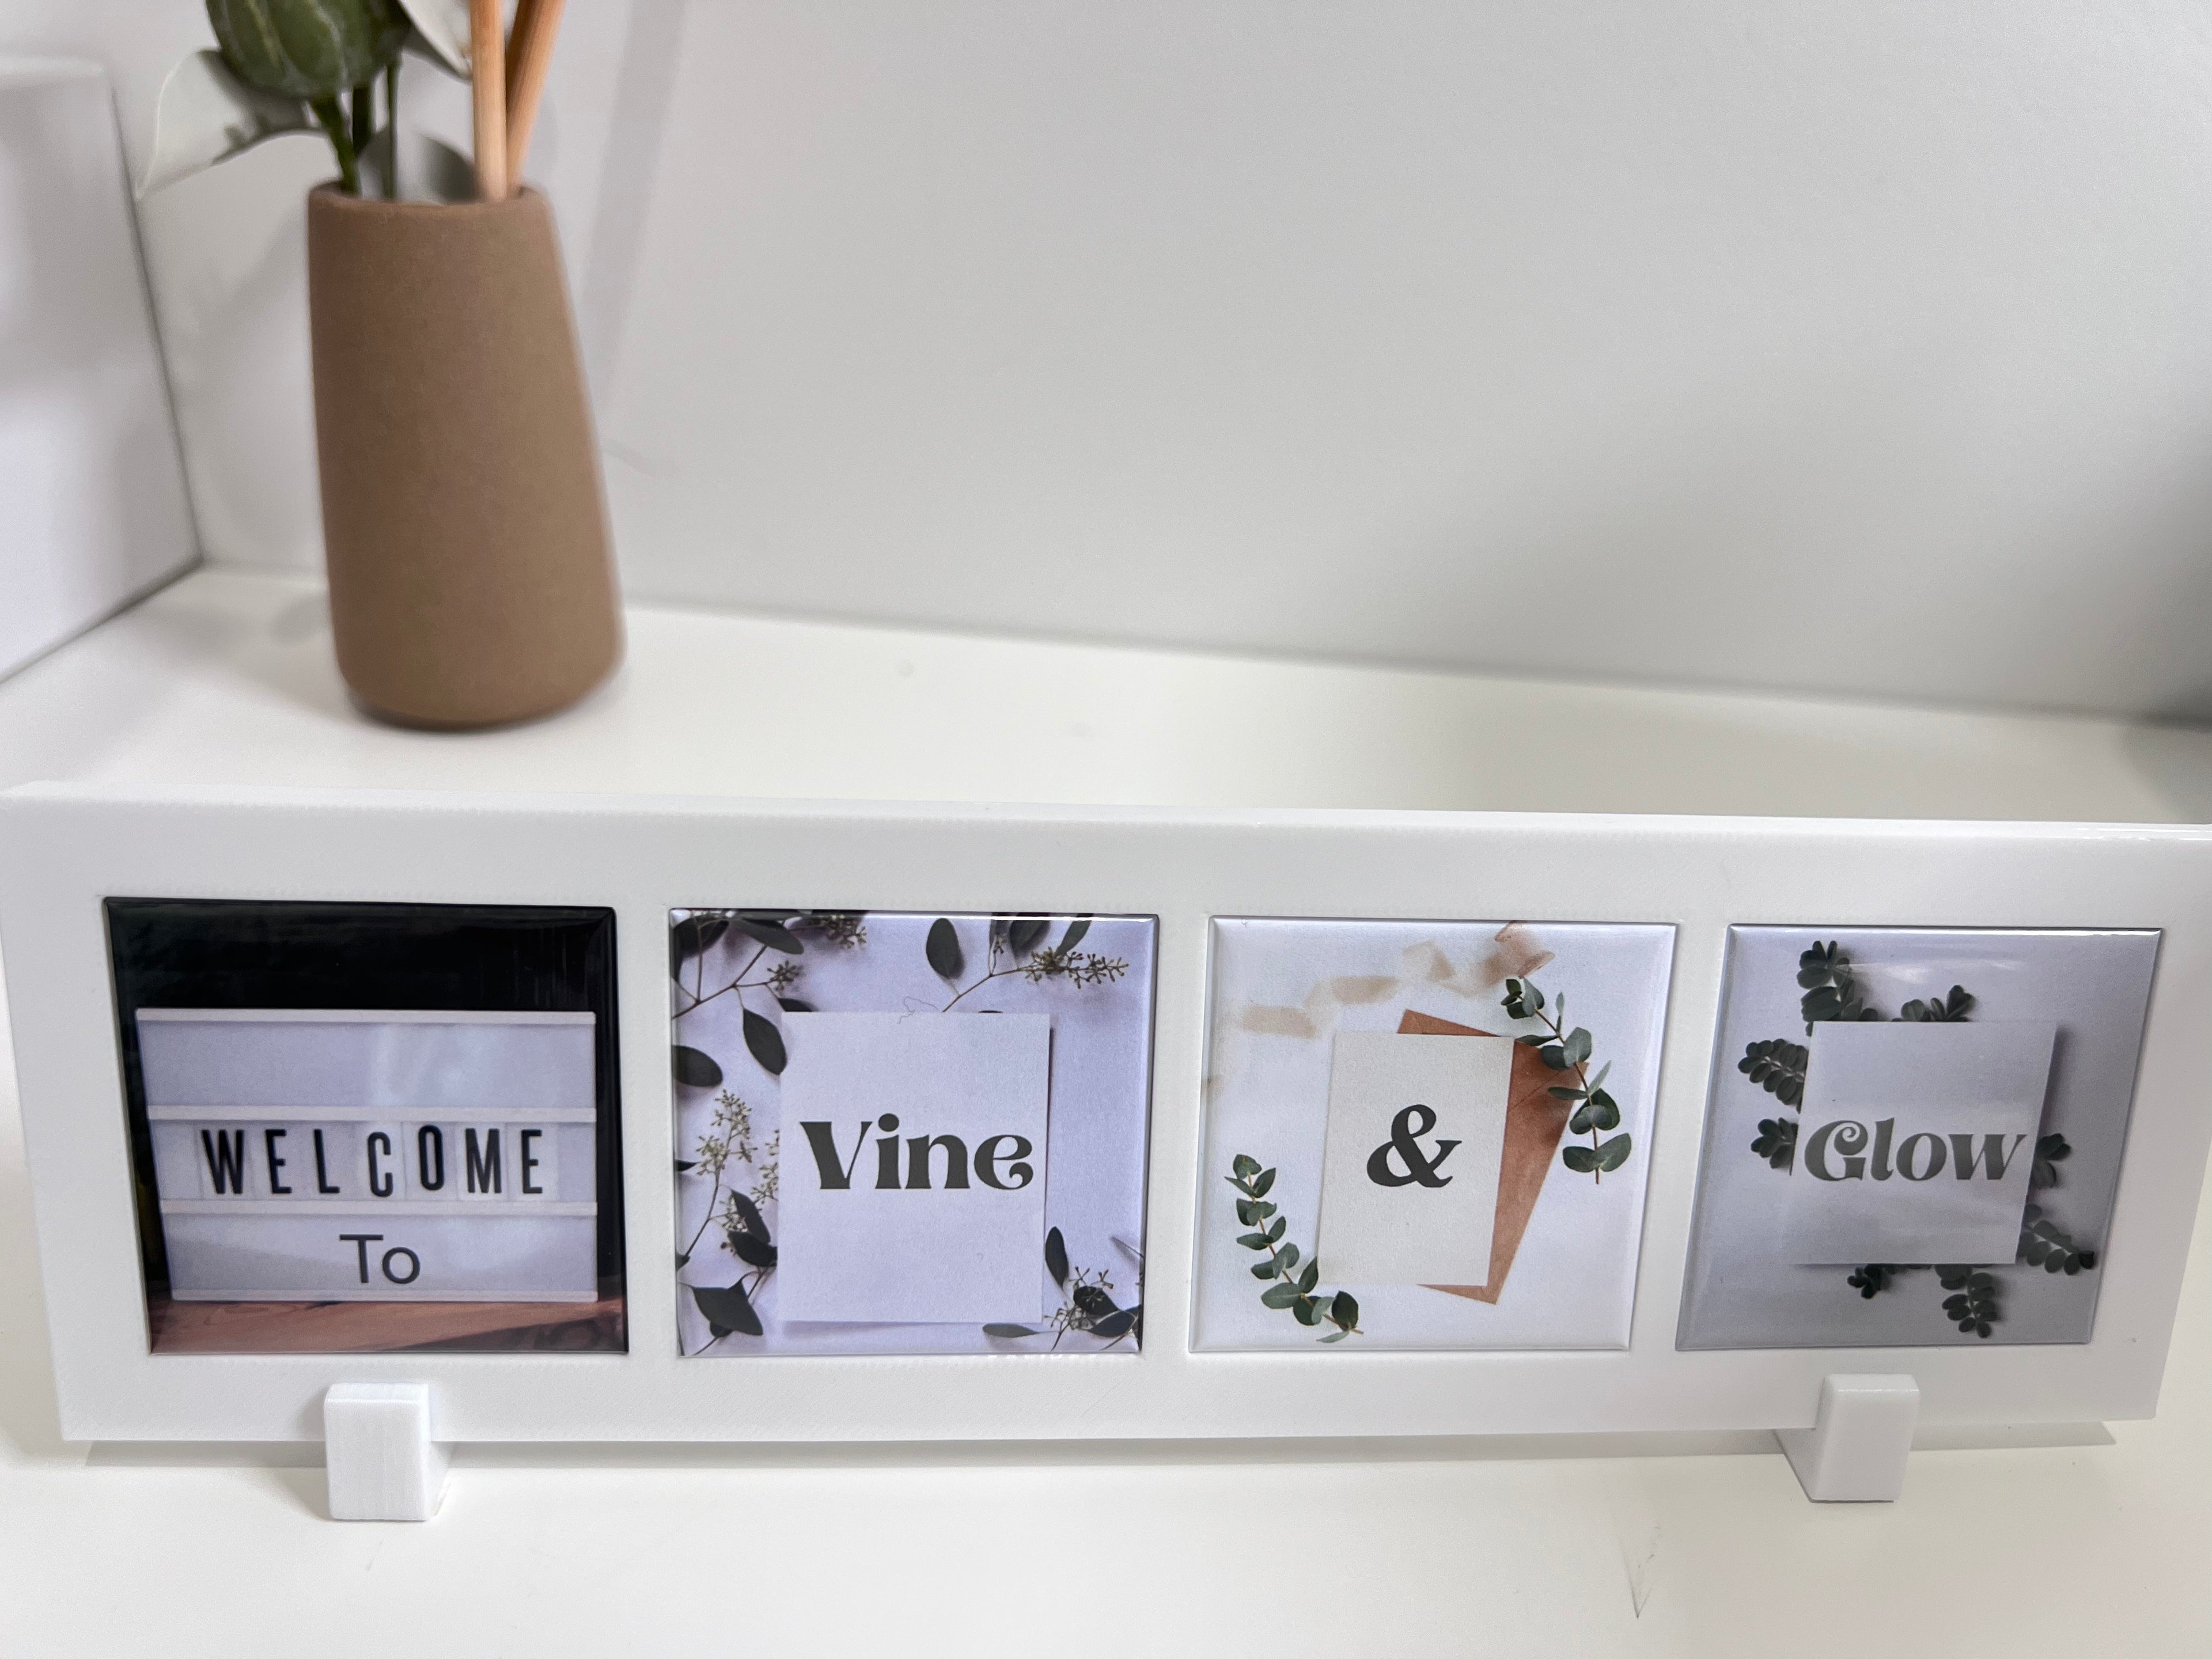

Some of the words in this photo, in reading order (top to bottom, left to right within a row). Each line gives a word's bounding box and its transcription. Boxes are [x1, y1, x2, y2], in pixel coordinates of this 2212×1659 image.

[200, 1124, 543, 1198] WELCOME
[799, 1113, 1034, 1190] Vine
[1366, 1104, 1463, 1188] &
[1804, 1117, 2027, 1182] Glow
[339, 1234, 421, 1285] To
